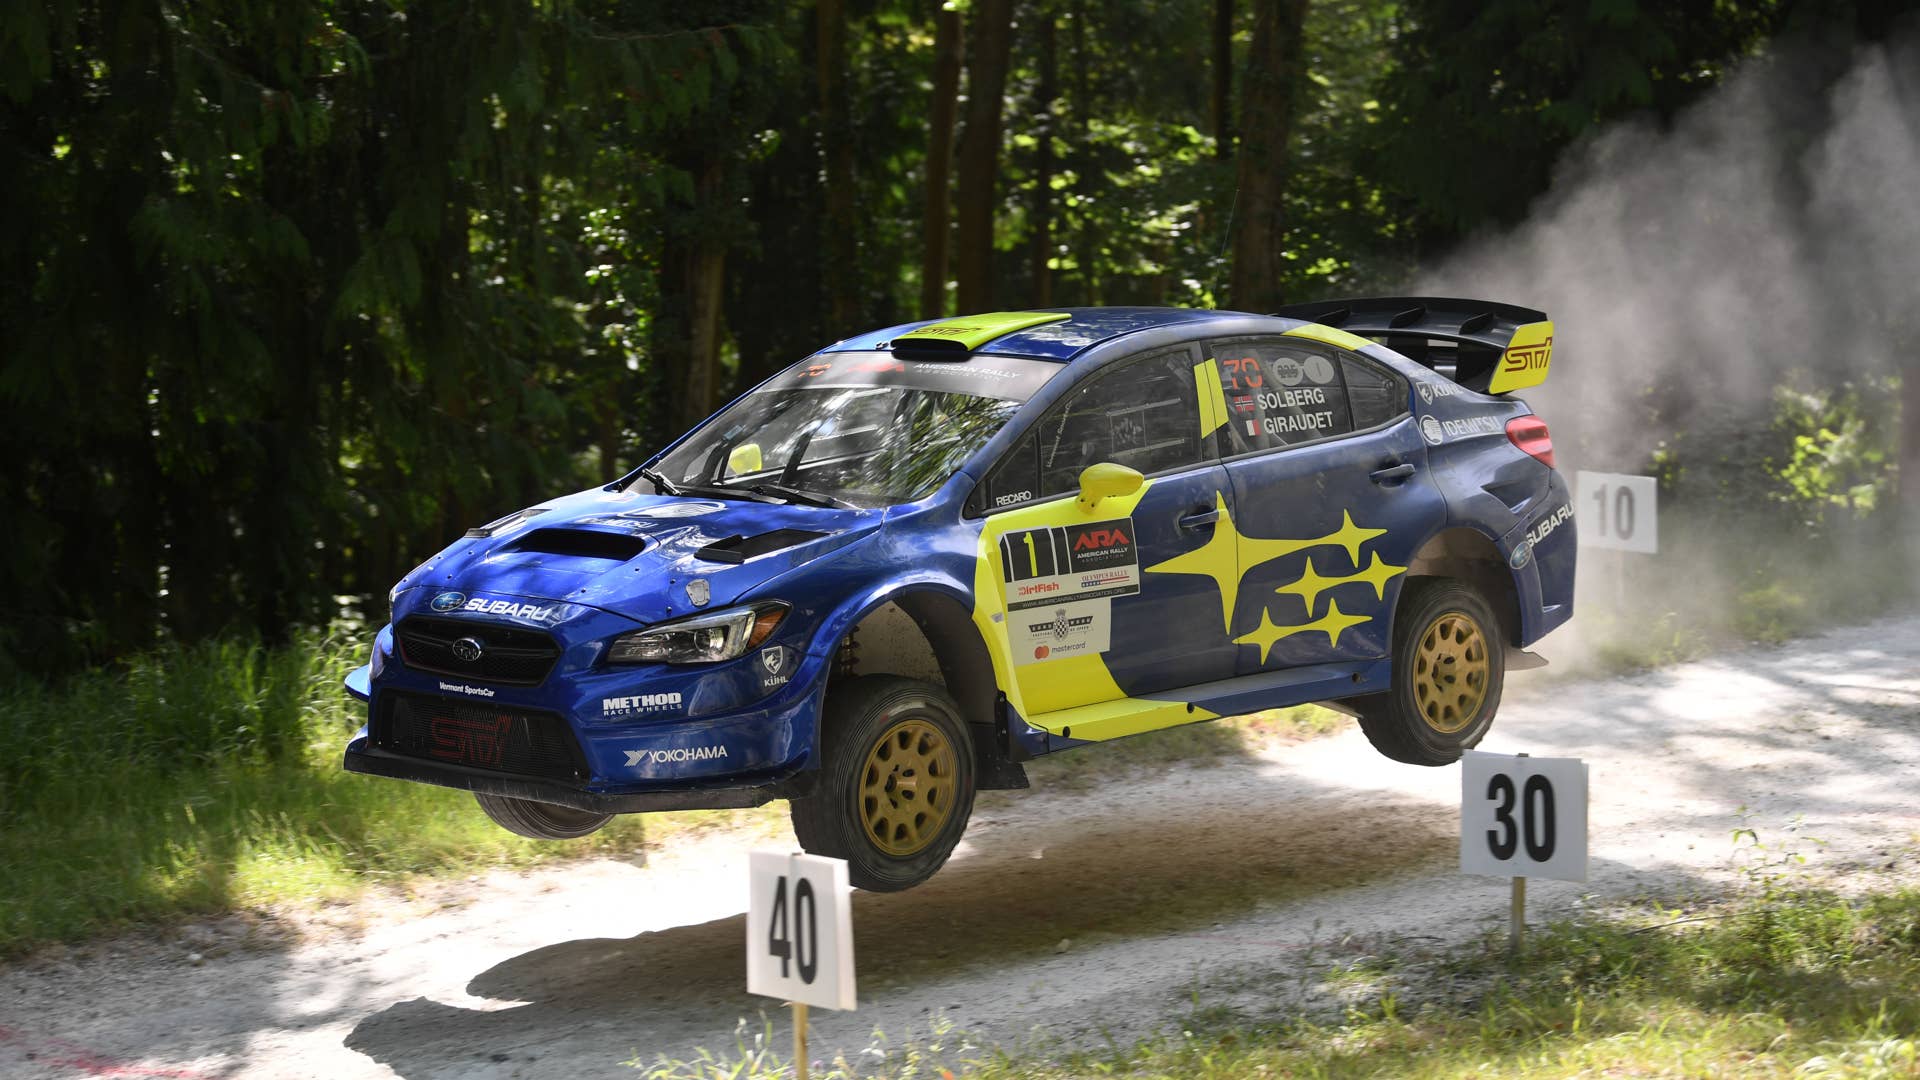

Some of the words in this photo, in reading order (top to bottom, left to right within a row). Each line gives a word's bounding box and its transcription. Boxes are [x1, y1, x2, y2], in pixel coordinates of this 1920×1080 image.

[914, 362, 979, 374] AMERICAN
[979, 367, 1024, 379] RALLY
[1223, 358, 1263, 390] 70
[1257, 387, 1325, 410] SOLBERG
[1263, 411, 1333, 434] GIRAUDET
[1442, 415, 1501, 437] IDEMITSU
[995, 490, 1032, 506] RECARO
[1592, 483, 1635, 541] 10
[1526, 501, 1576, 549] SUBARU
[1073, 528, 1130, 552] ARA
[1023, 531, 1038, 577] 1
[1077, 549, 1109, 560] AMERICAN
[1109, 546, 1128, 555] RALLY
[1018, 582, 1060, 597] DirtFish
[464, 598, 551, 621] SUBARU
[1051, 641, 1086, 653] mastercard
[439, 681, 464, 693] Vermont
[464, 685, 495, 697] SportsCar
[764, 675, 789, 688] KÜHL
[603, 692, 682, 710] METHOD
[603, 708, 631, 717] RACE
[636, 703, 683, 713] WHEELS
[648, 745, 728, 764] YOKOHAMA
[1486, 773, 1556, 863] 30
[769, 875, 817, 985] 40
